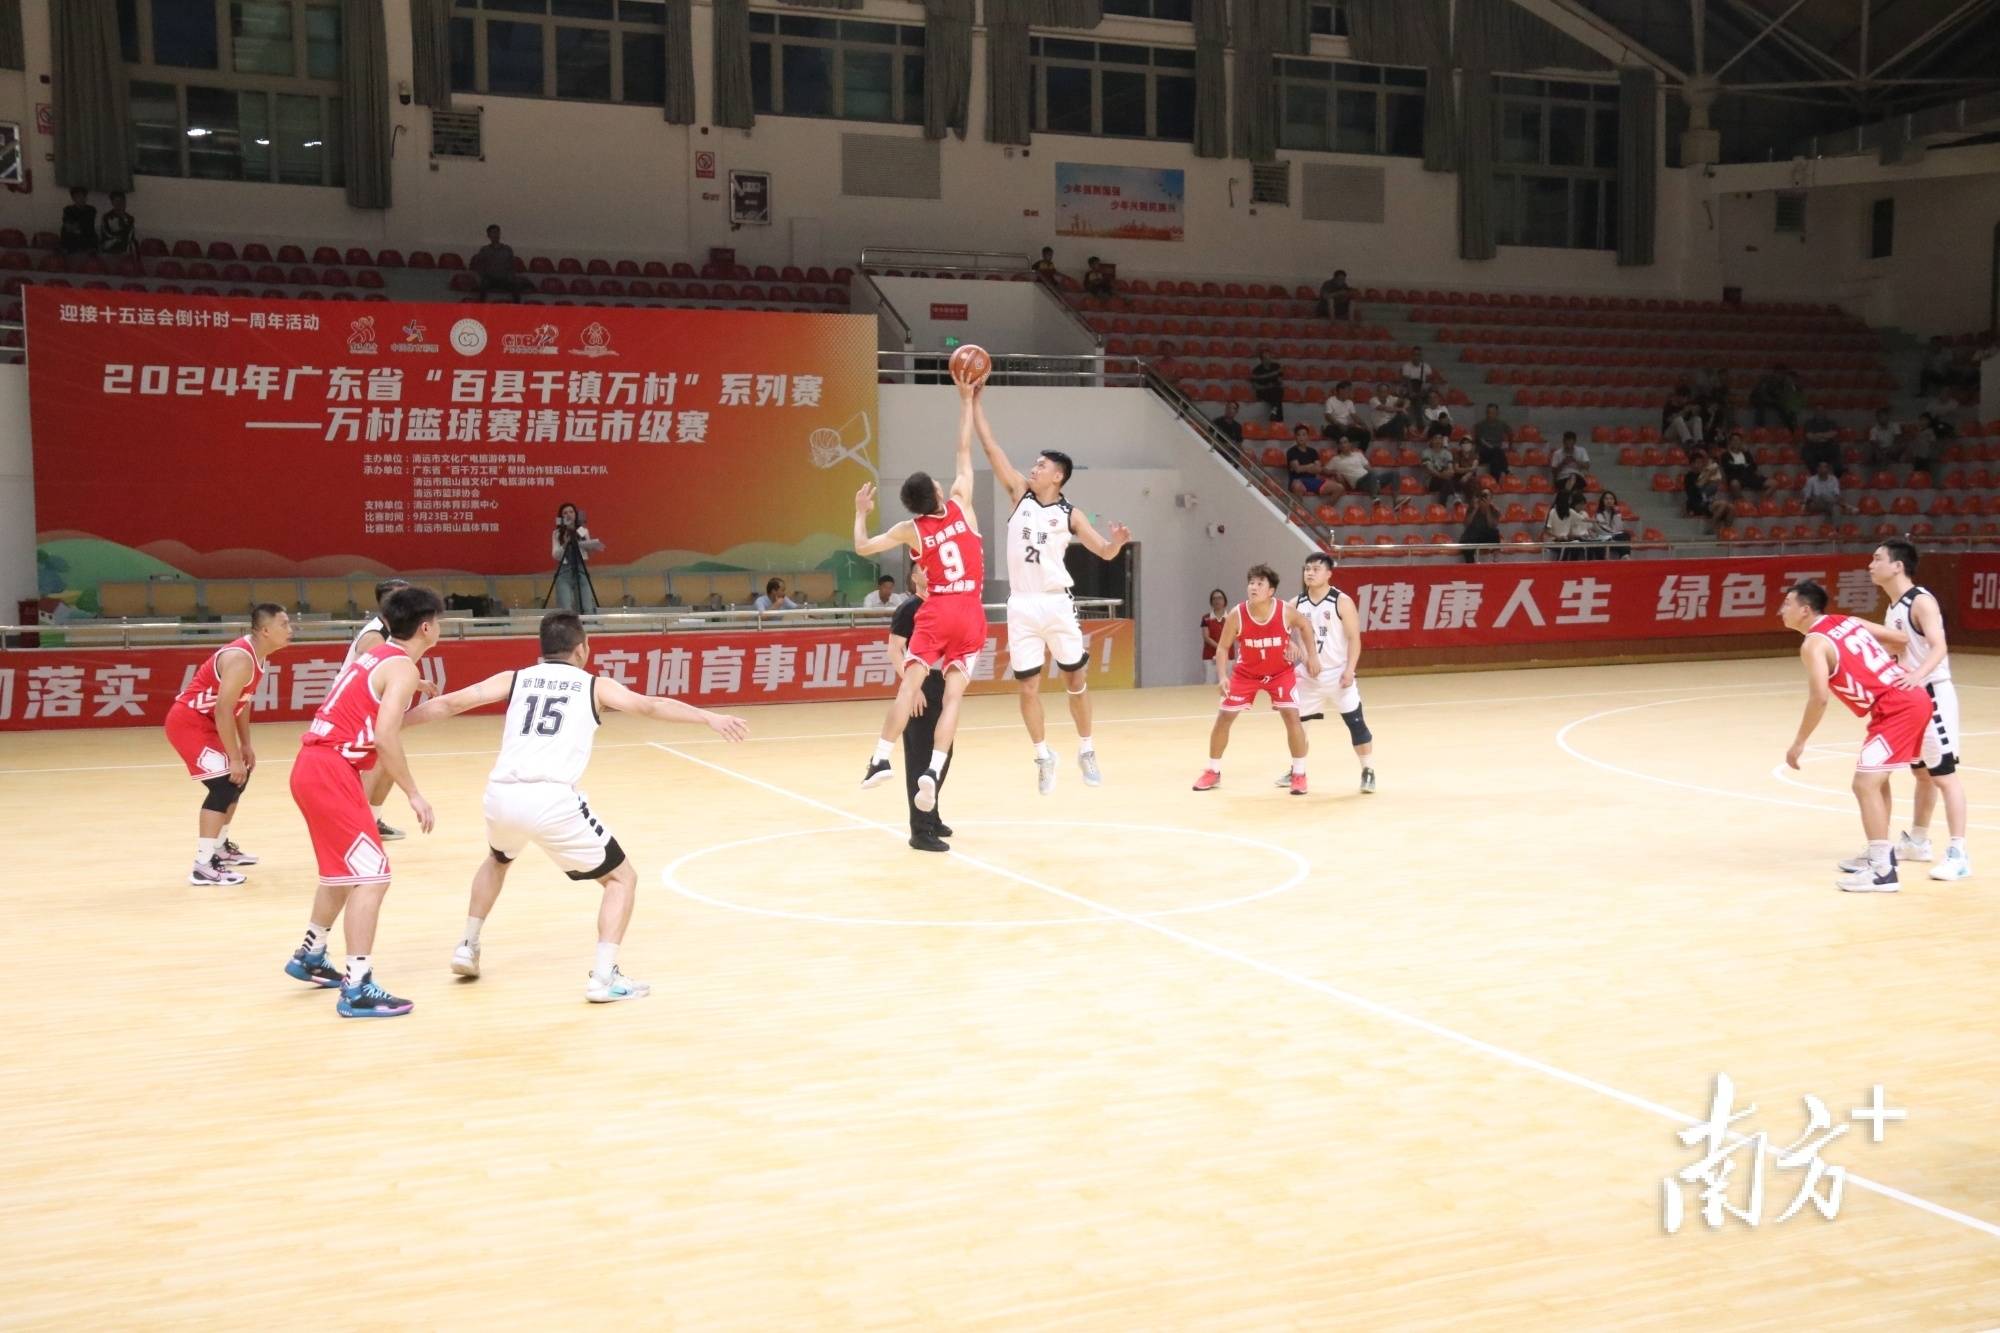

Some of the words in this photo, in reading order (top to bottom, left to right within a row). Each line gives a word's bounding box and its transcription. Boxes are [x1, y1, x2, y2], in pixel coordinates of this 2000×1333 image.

[59, 304, 320, 332] 迎接十五运会倒计时一周年活动
[939, 541, 965, 582] 9
[1355, 577, 1612, 634] 健康人生
[1971, 573, 2000, 610] 20
[520, 694, 570, 737] 15
